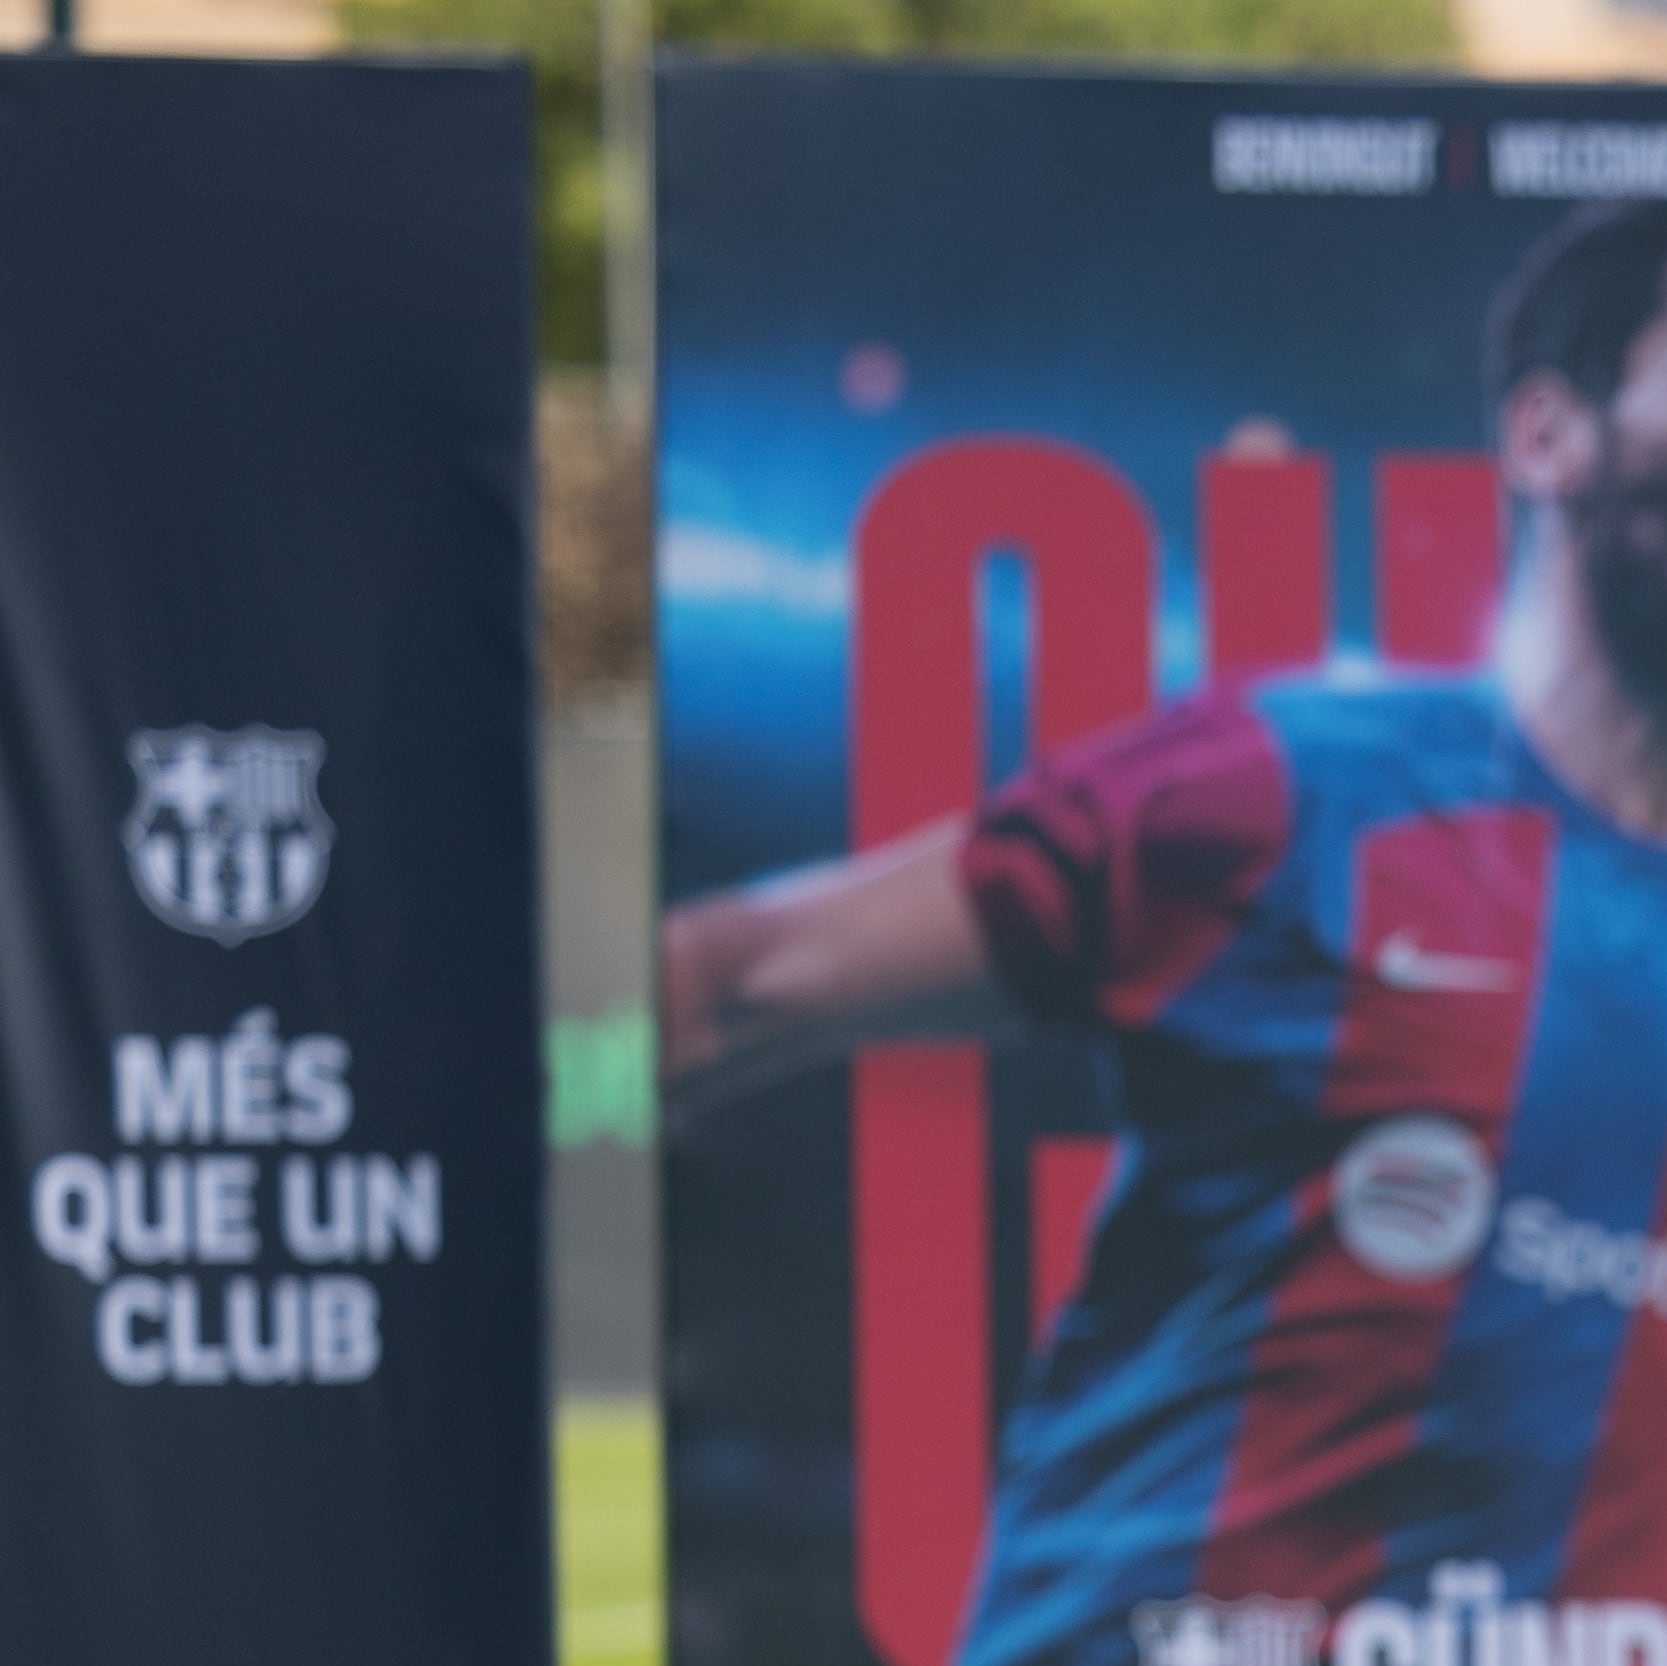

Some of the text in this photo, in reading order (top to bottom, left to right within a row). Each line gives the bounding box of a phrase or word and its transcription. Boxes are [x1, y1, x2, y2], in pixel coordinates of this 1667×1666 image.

[115, 1006, 351, 1144] MÉS
[32, 1153, 442, 1282] QUE UN
[97, 1274, 382, 1384] CLUB
